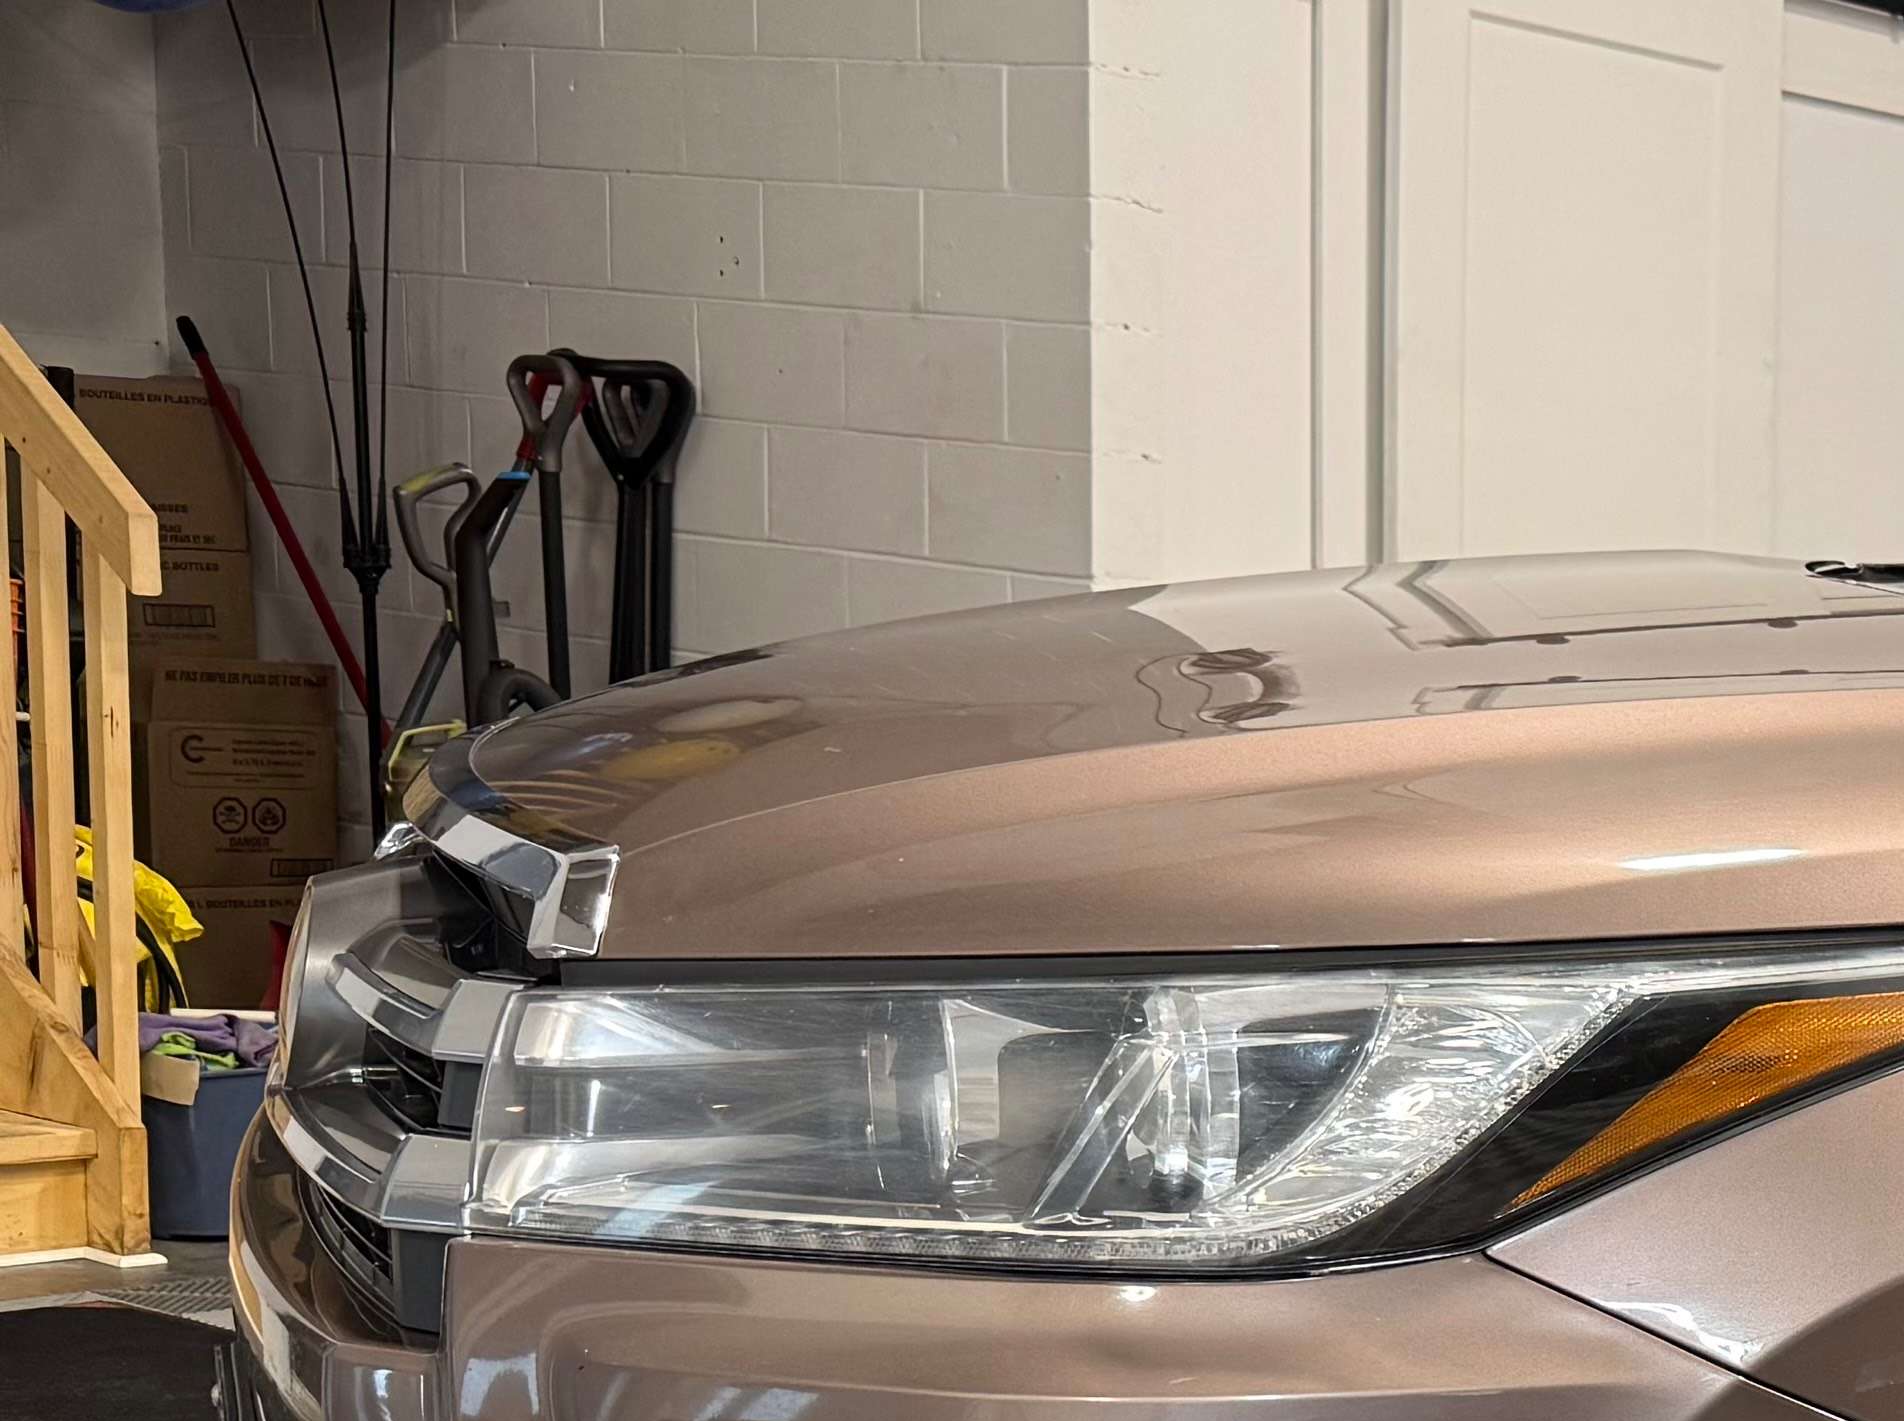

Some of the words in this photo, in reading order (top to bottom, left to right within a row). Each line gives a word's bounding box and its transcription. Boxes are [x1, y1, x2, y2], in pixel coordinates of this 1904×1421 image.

[79, 388, 145, 402] BOUTEILLES
[147, 393, 162, 403] EN
[164, 393, 210, 407] PLASTIQ
[172, 561, 220, 572] BOTTLES
[229, 837, 270, 848] DANGER
